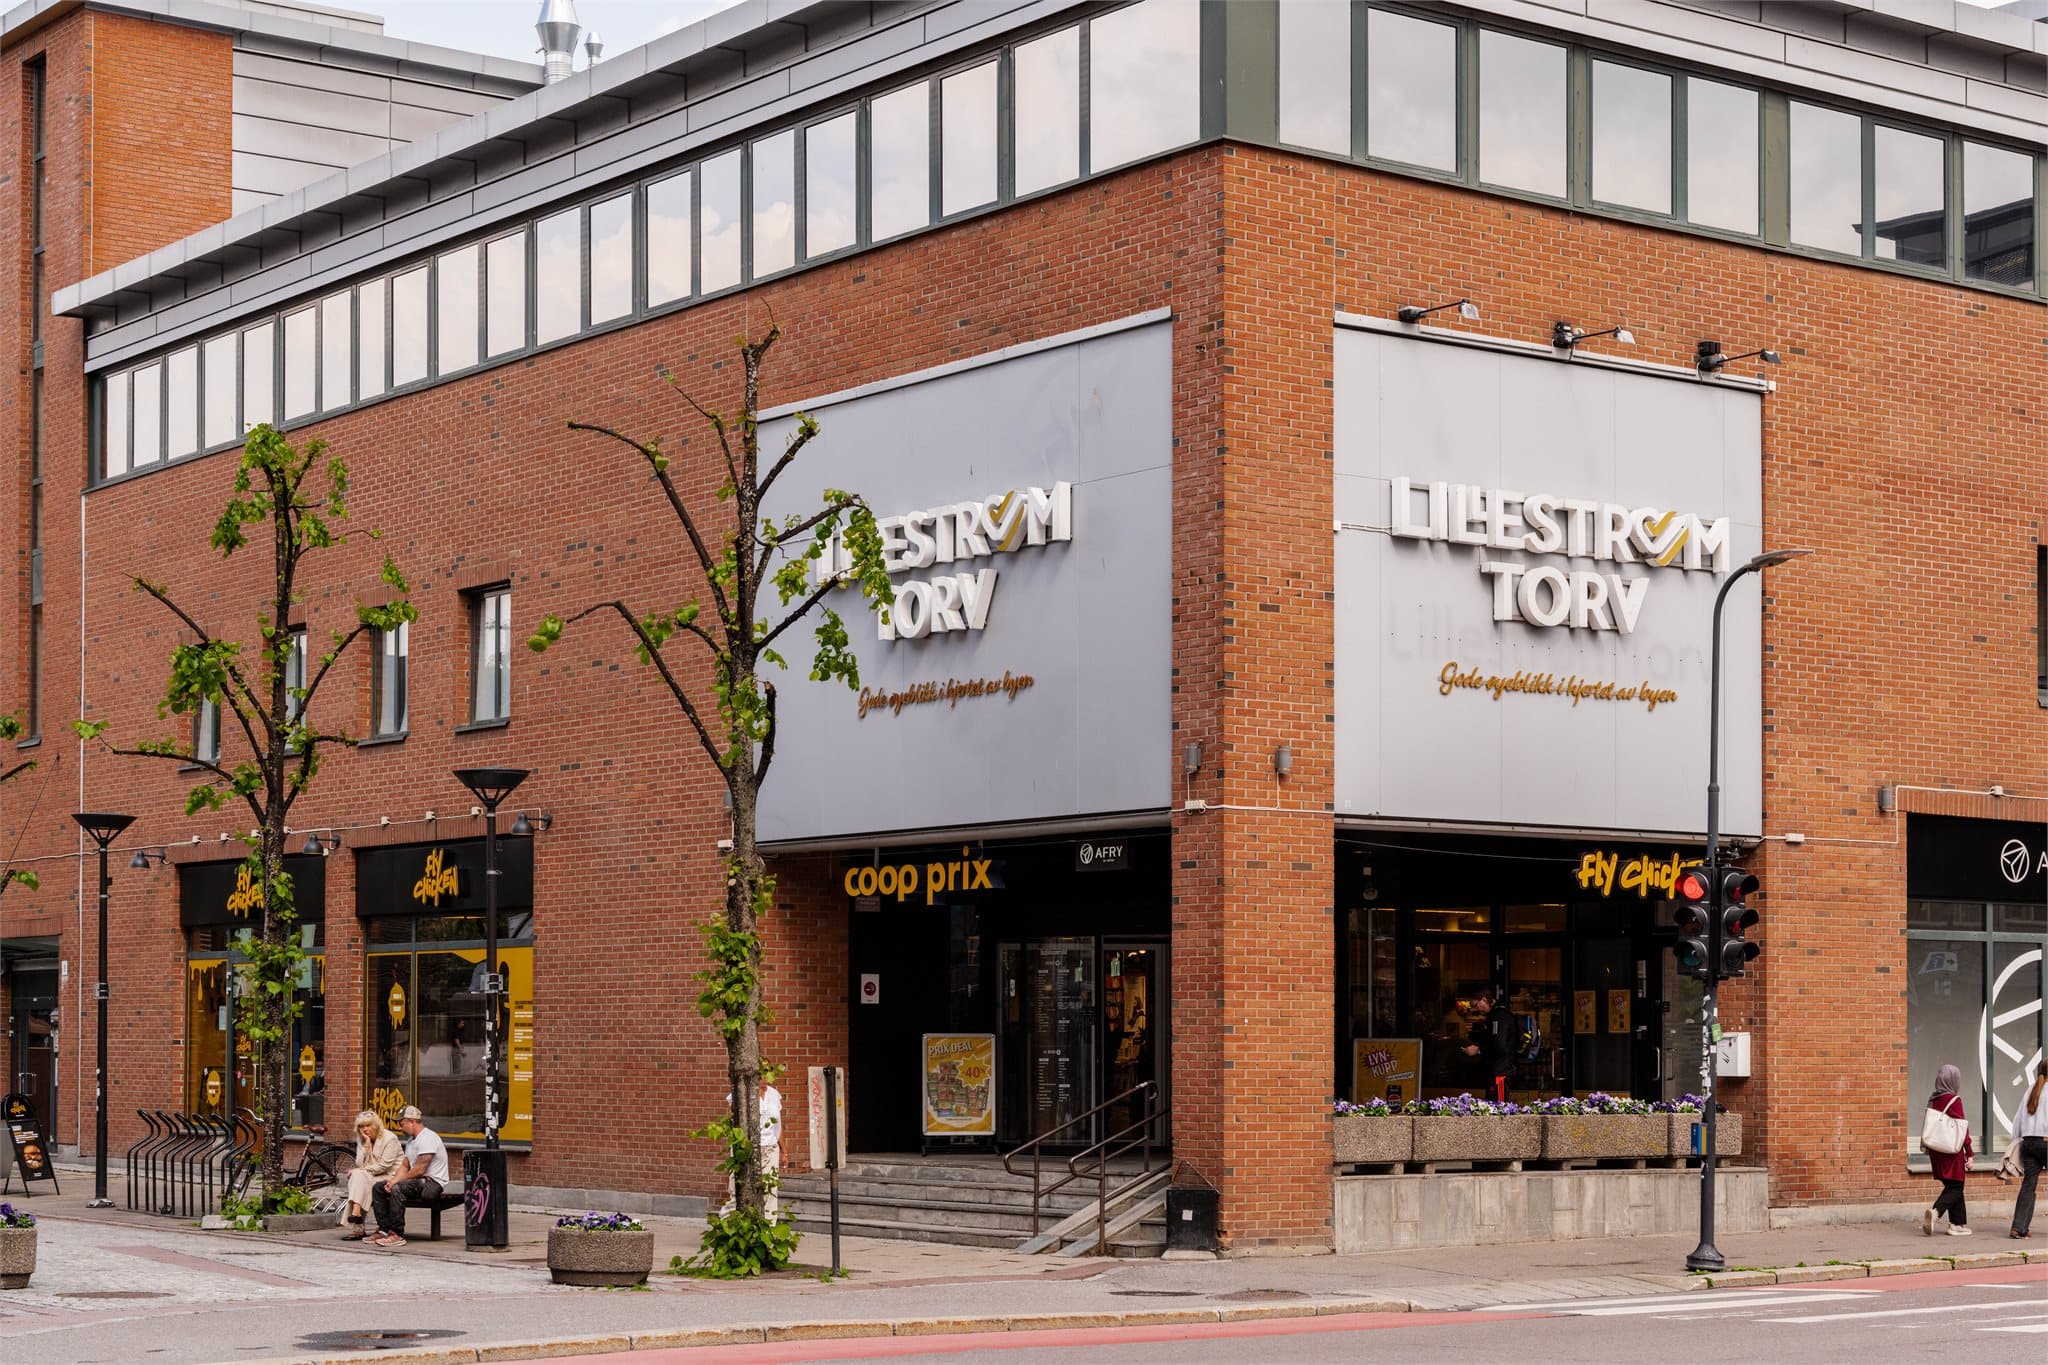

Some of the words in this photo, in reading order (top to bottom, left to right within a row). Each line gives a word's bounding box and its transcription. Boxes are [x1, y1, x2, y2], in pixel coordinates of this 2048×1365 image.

[1480, 560, 1650, 635] TORV
[857, 687, 886, 718] Gode
[937, 682, 945, 703] i
[985, 680, 1000, 694] av
[1001, 670, 1034, 702] byen
[1440, 661, 1484, 695] Gode
[1556, 677, 1566, 697] i
[1566, 674, 1616, 708] hjertet
[1615, 686, 1638, 701] av
[1638, 680, 1679, 712] byen
[844, 864, 919, 902] coop
[926, 846, 993, 906] prix
[1095, 846, 1123, 858] AFRY
[928, 1045, 952, 1056] PRIX
[952, 1041, 974, 1052] DEAL
